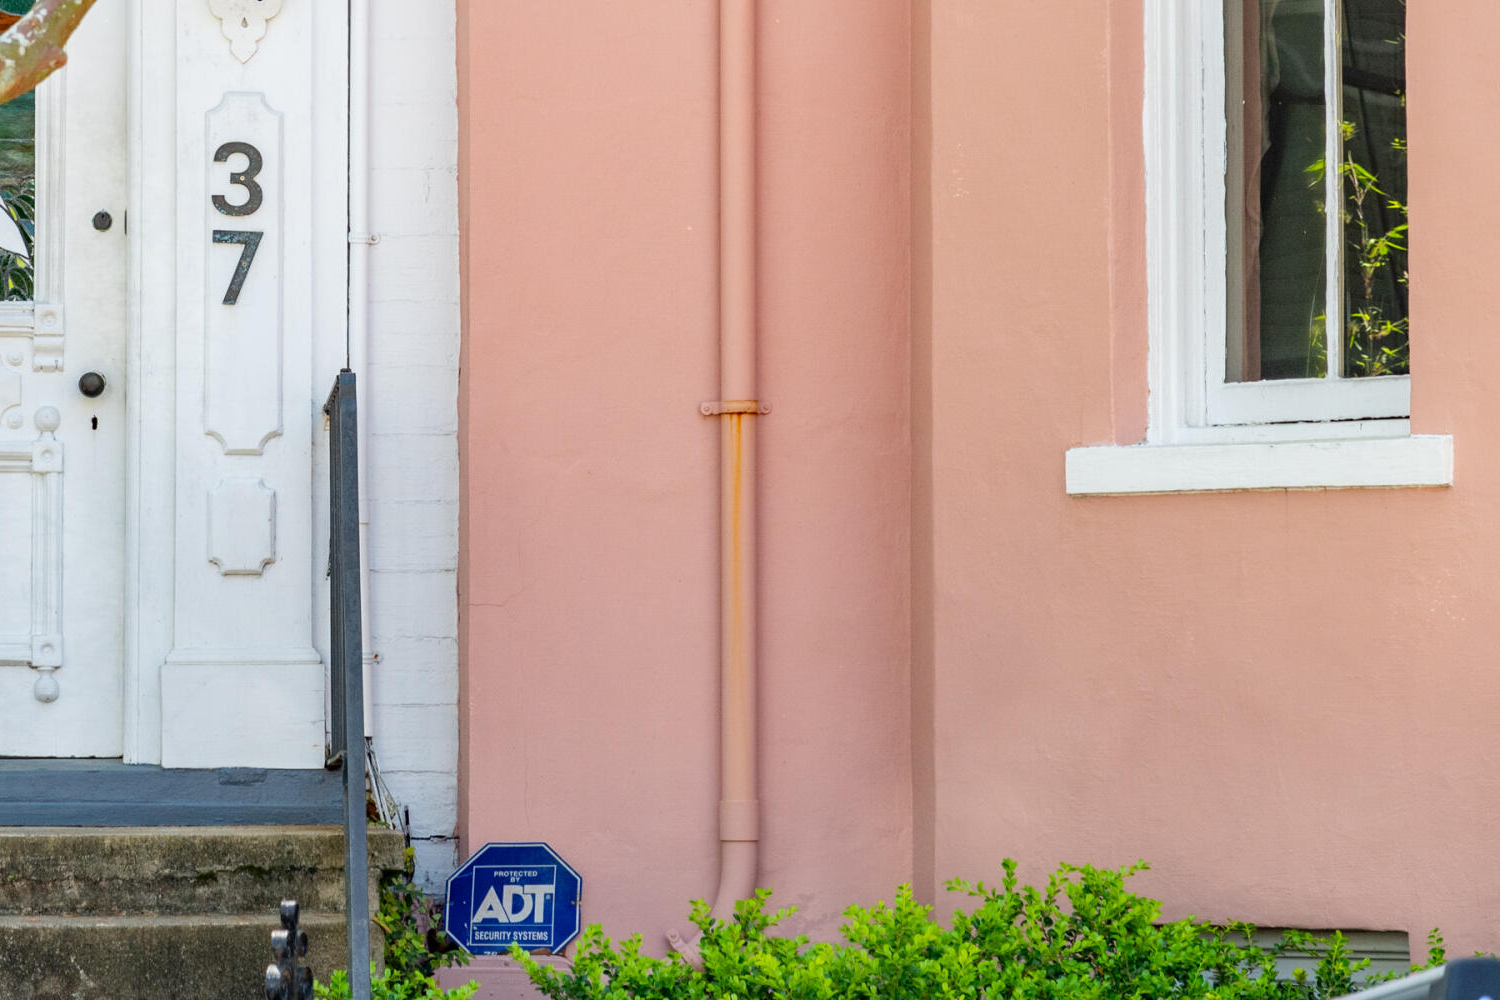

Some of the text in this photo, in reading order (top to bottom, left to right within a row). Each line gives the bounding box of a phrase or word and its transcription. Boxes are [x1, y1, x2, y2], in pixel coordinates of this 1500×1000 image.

[472, 884, 555, 923] ADT
[474, 931, 548, 941] SECURITY SYSTEMS
